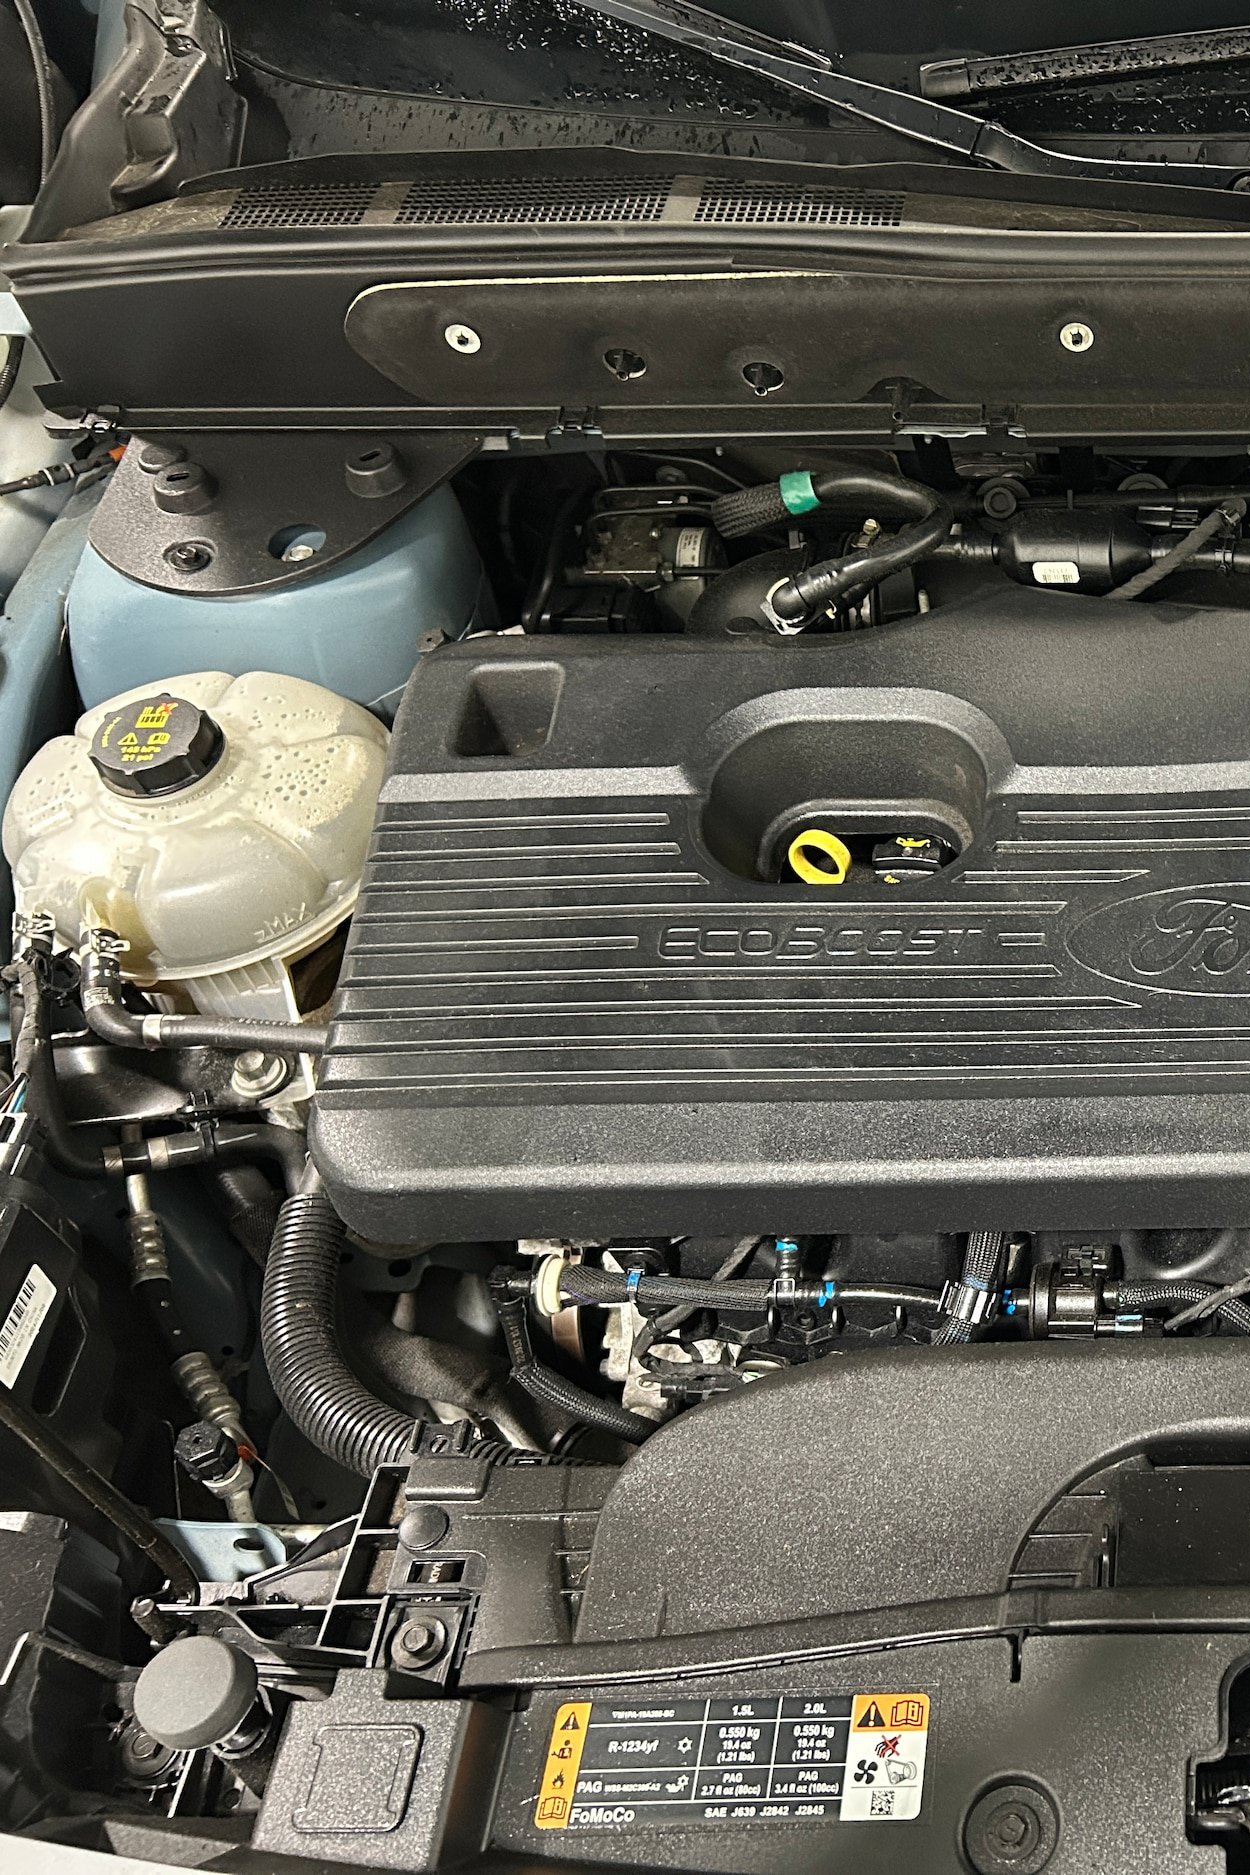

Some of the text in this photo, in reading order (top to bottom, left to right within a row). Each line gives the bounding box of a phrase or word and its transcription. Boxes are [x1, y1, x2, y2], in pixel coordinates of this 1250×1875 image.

[263, 902, 311, 935] MAX
[732, 1705, 755, 1716] 1.5L
[803, 1703, 827, 1714] 2.0L
[719, 1727, 760, 1739] 0.550 kg
[793, 1725, 835, 1738] 0.550 kg
[608, 1740, 659, 1753] R-1234yf
[722, 1740, 752, 1749] 19.4 oz
[797, 1739, 826, 1749] 19.4 oz
[717, 1751, 755, 1763] (1.21 lbs)
[792, 1750, 830, 1762] (1.21 lbs)
[723, 1772, 743, 1783] PAG
[798, 1770, 819, 1781] PAG
[576, 1781, 602, 1794] PAG
[701, 1785, 715, 1795] 2.7
[723, 1785, 734, 1795] oz
[734, 1783, 761, 1796] (80cc)
[774, 1784, 788, 1794] 3.4
[797, 1784, 808, 1793] oz
[808, 1783, 839, 1795] (100cc)
[569, 1806, 636, 1824] FoMoCo
[704, 1804, 826, 1817] SAE J639 J2842 J2845
